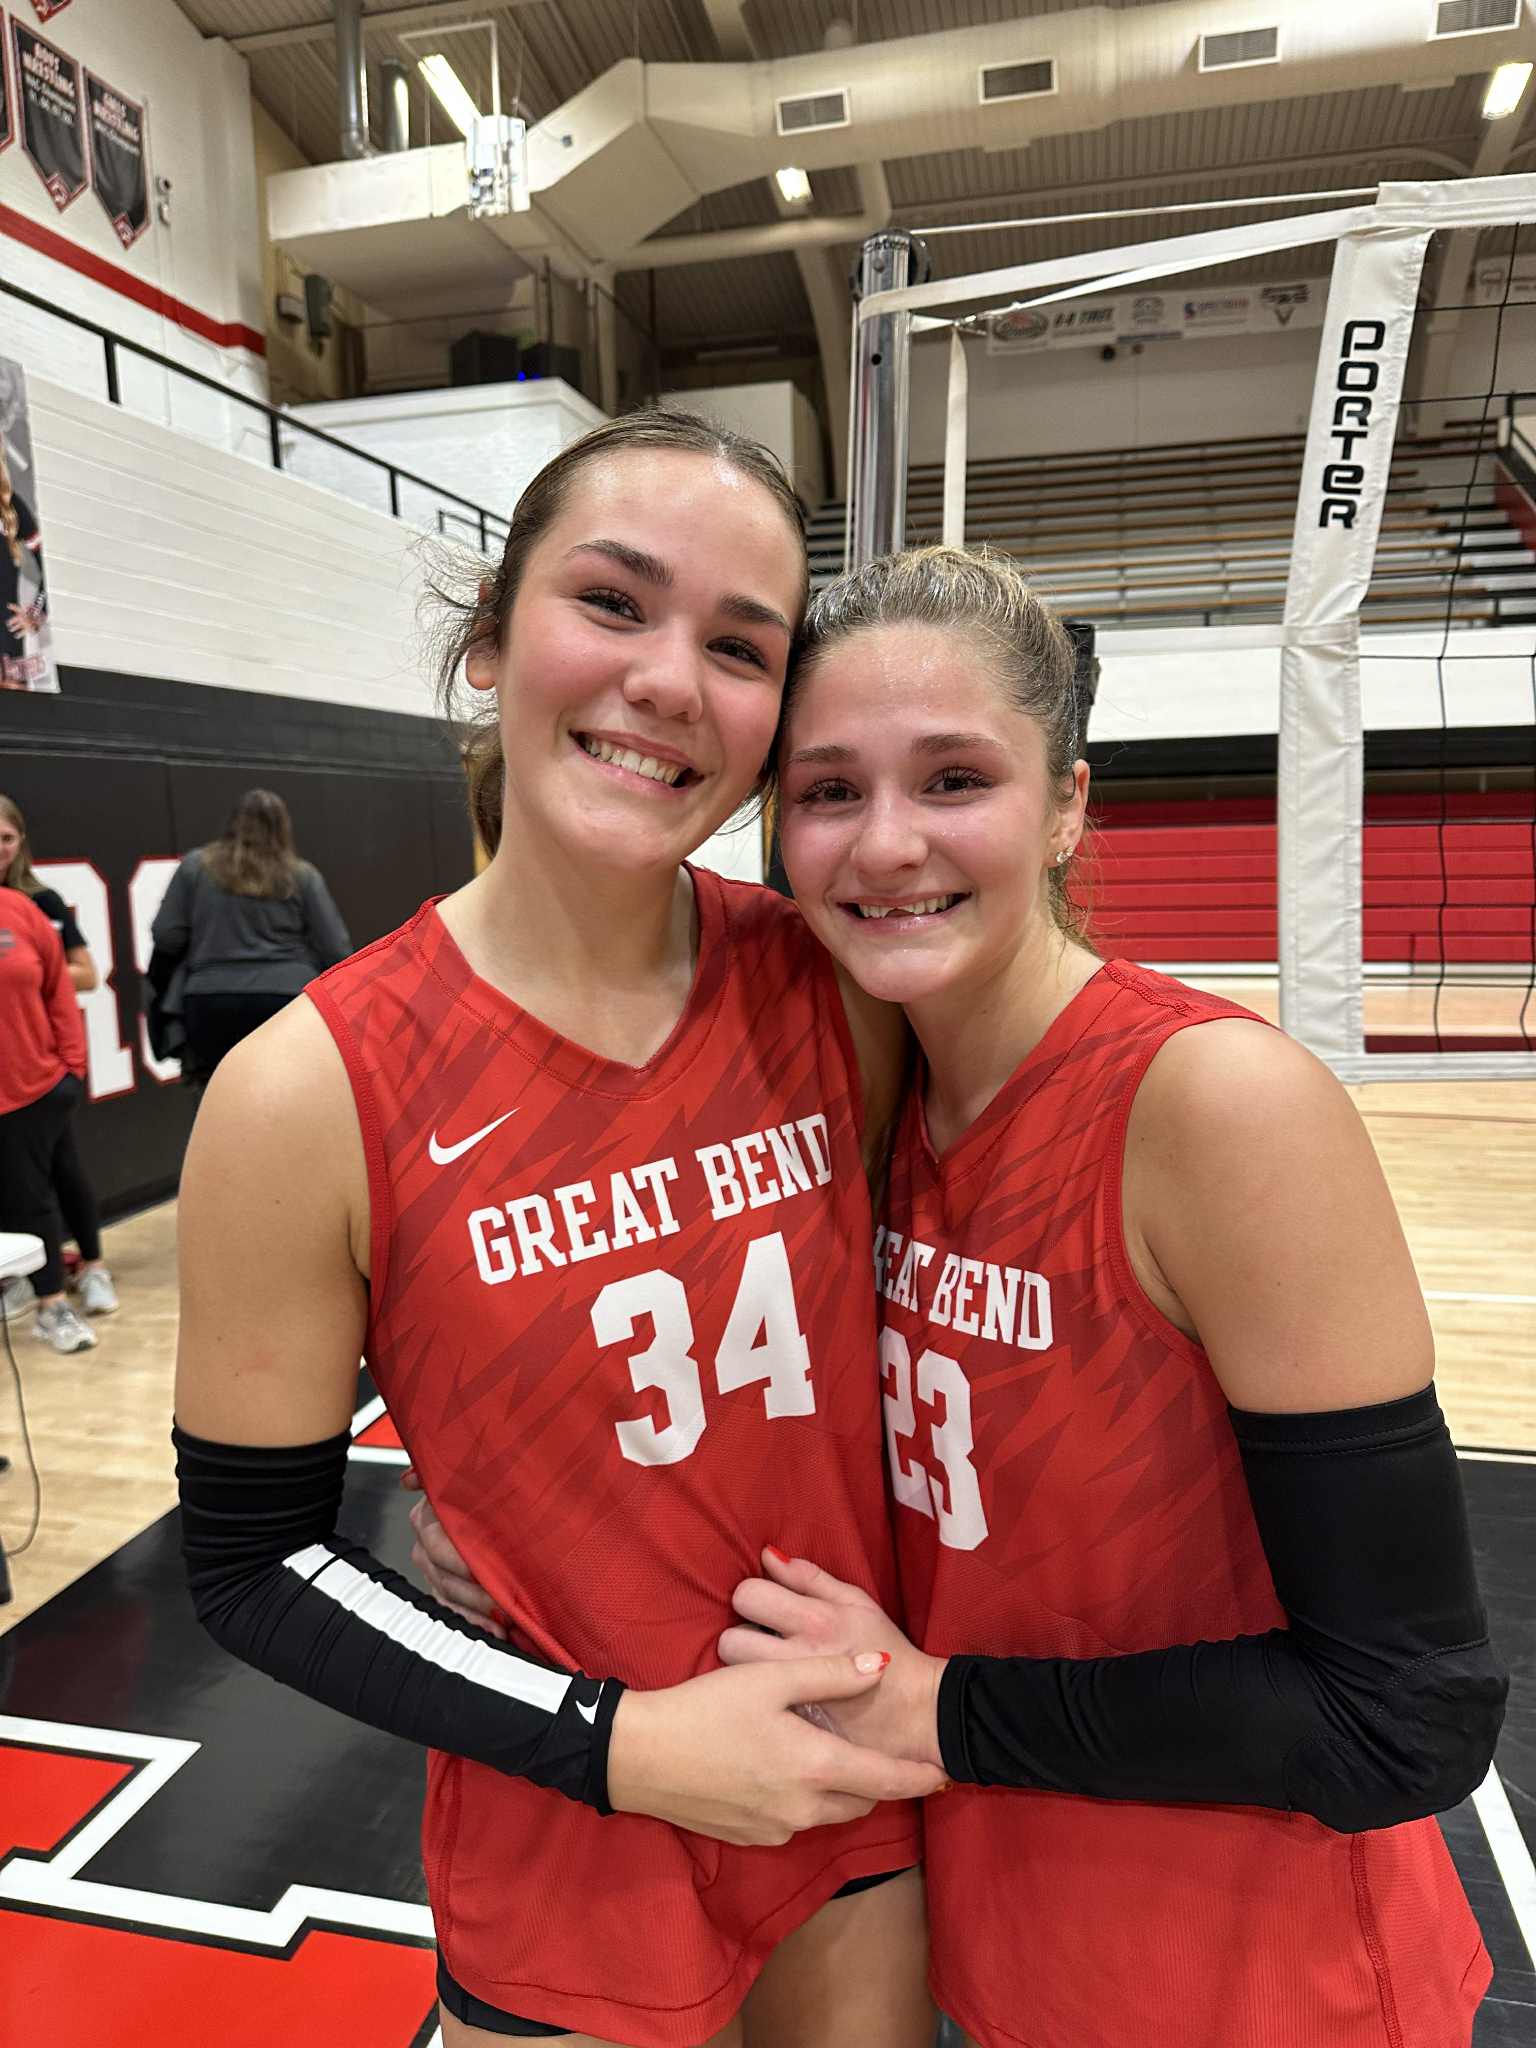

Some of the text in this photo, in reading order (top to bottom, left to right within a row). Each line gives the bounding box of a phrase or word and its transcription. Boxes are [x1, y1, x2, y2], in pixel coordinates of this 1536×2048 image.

[467, 1112, 832, 1286] GREAT BEND
[590, 1231, 817, 1467] 34
[928, 1252, 1053, 1351] BEND
[878, 1325, 989, 1551] 23
